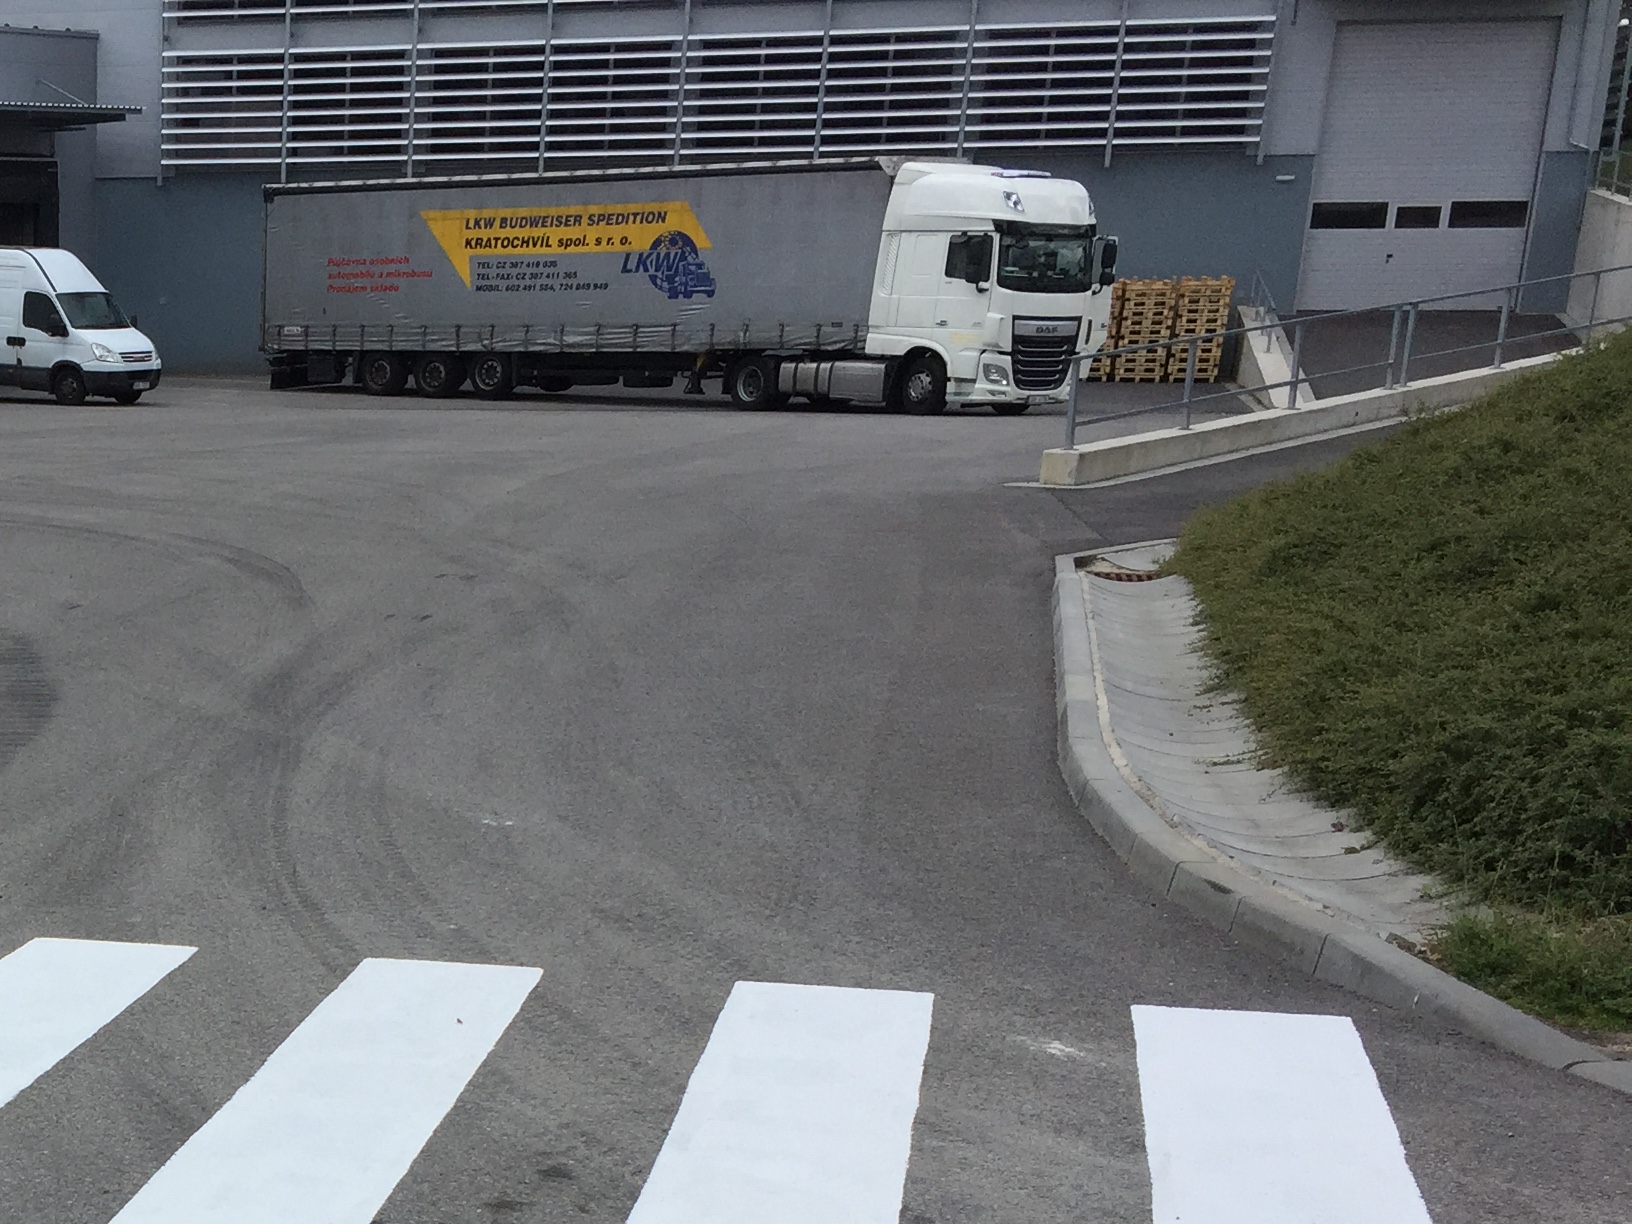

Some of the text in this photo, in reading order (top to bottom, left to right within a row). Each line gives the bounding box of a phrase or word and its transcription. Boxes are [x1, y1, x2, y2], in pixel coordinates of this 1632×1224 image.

[465, 211, 668, 230] LKW BUDWEISER SPEDITION
[464, 232, 632, 250] KRATOCHVÍL spol. s r. o.
[496, 261, 507, 269] CZ
[621, 250, 681, 274] LKW
[515, 272, 527, 280] CZ
[1035, 326, 1058, 334] DAF
